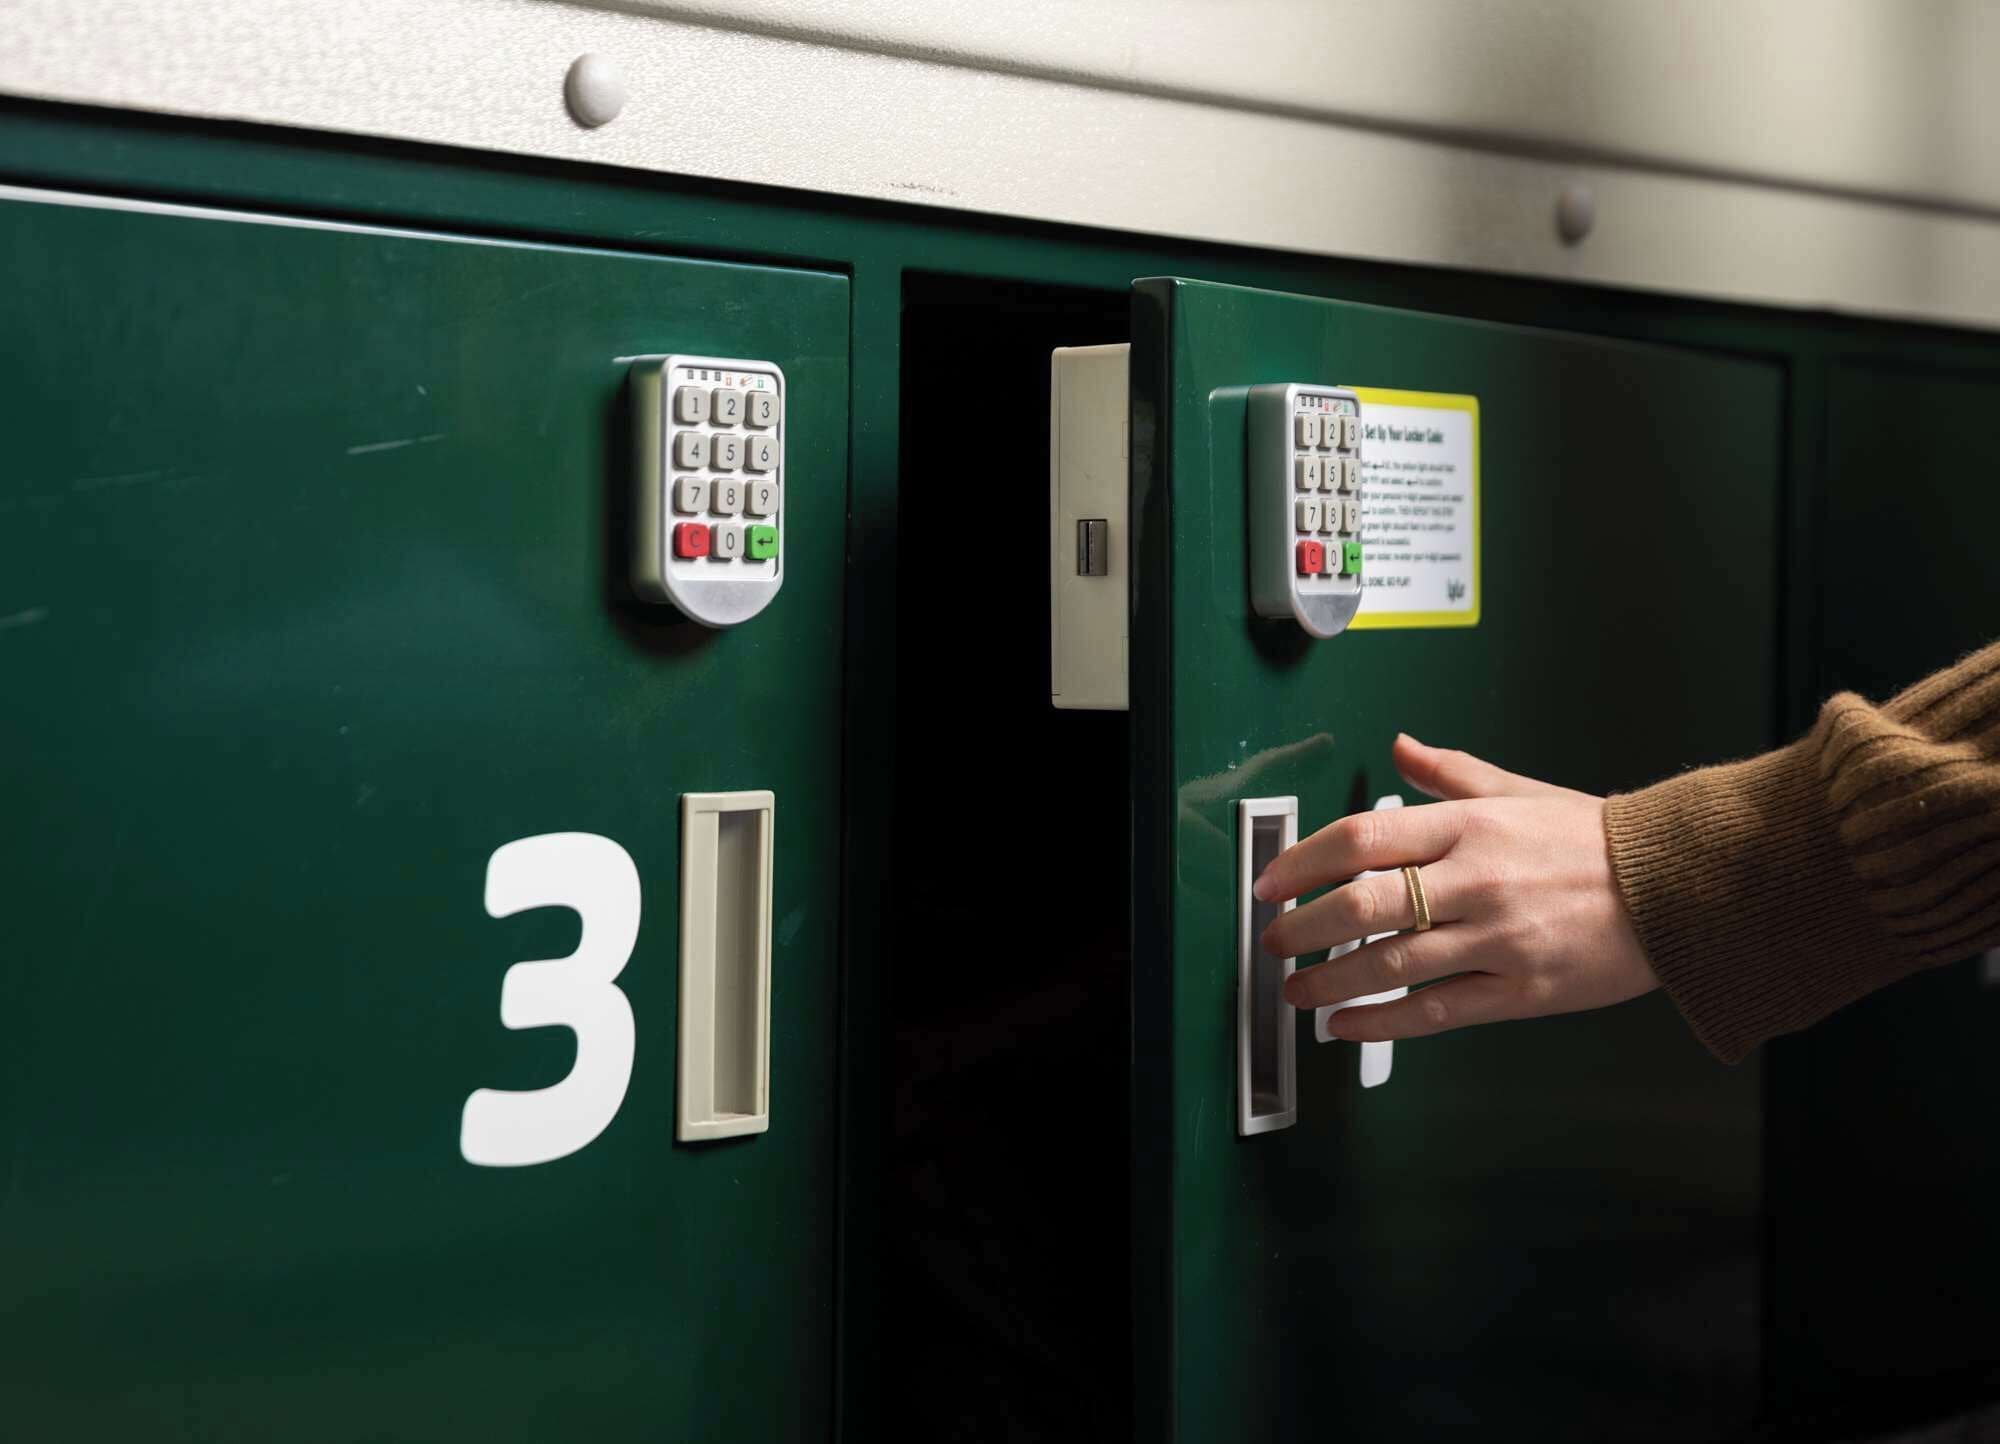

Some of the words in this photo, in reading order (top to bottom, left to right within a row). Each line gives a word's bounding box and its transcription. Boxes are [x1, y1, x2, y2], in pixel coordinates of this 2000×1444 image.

[692, 396, 699, 415] 1
[726, 398, 736, 416] 2
[761, 401, 770, 418] 3
[1329, 423, 1335, 440] 2
[1350, 424, 1356, 441] 3
[691, 442, 700, 459] 4
[726, 444, 735, 461] 5
[760, 445, 769, 462] 6
[1309, 465, 1314, 481] 4
[1330, 465, 1335, 482] 5
[1351, 466, 1356, 483] 6
[691, 486, 700, 504] 7
[727, 488, 735, 506] 8
[760, 489, 769, 505] 9
[1310, 506, 1316, 524] 7
[1331, 507, 1336, 525] 8
[1351, 508, 1356, 524] 9
[689, 530, 701, 549] C
[726, 532, 735, 550] 0
[1310, 548, 1317, 565] C
[1331, 550, 1337, 567] 0
[460, 831, 642, 1168] 3
